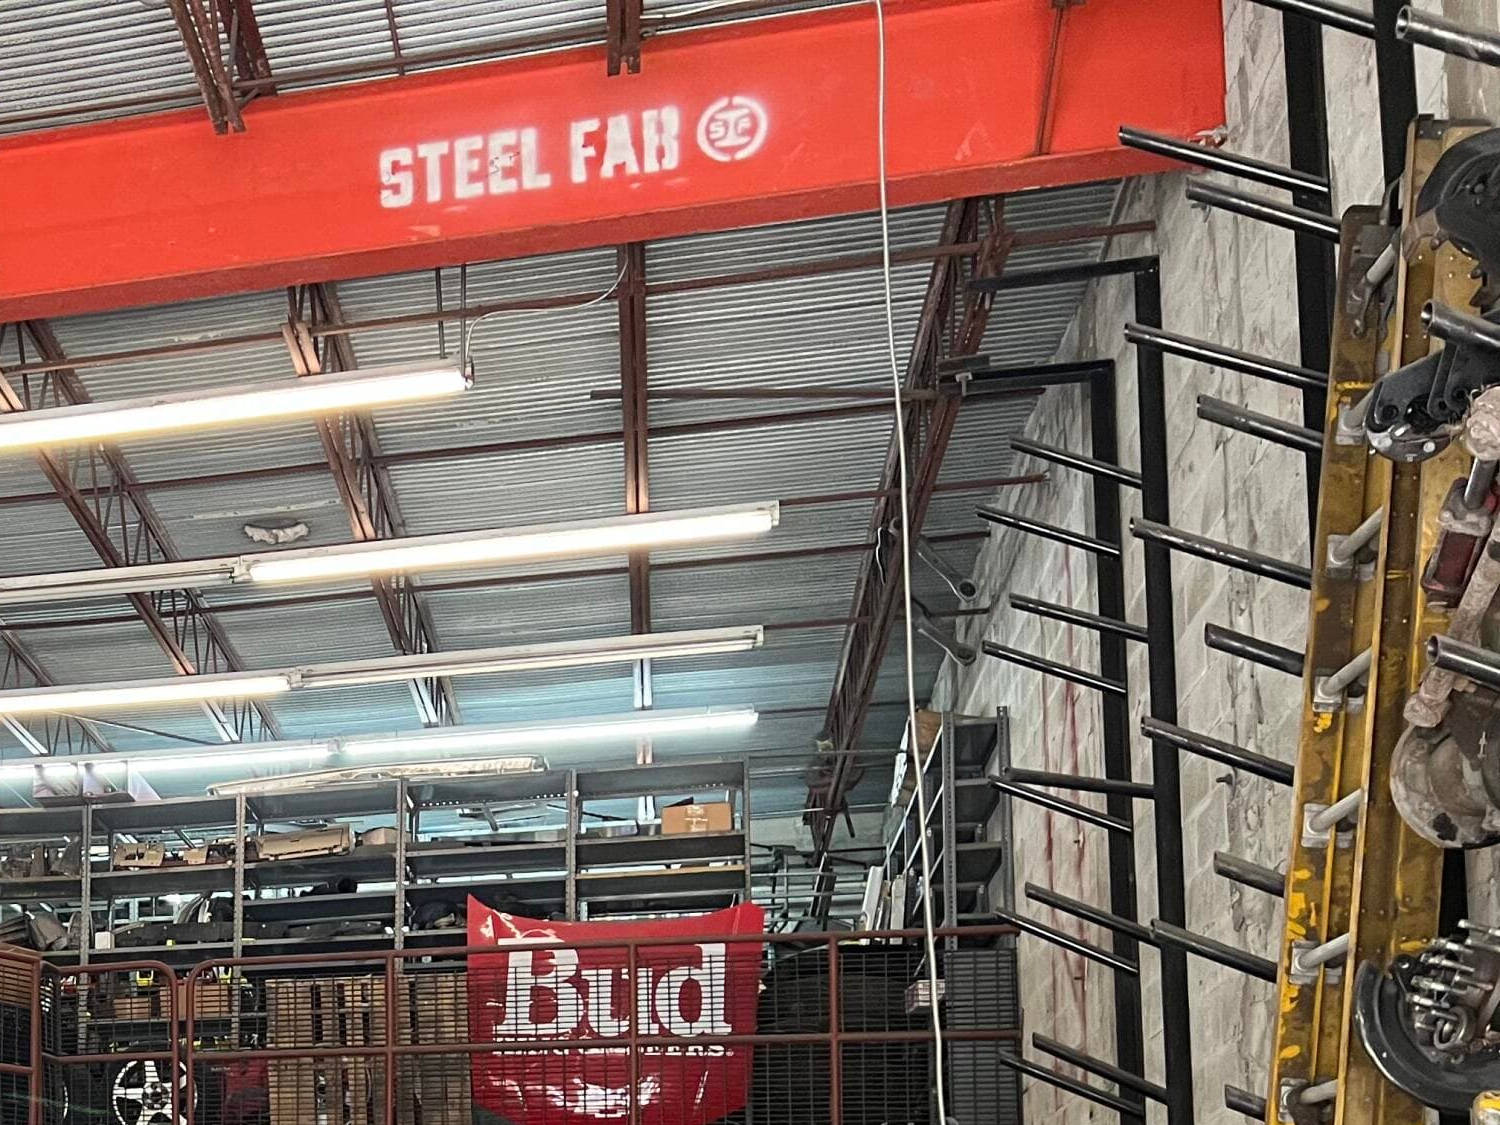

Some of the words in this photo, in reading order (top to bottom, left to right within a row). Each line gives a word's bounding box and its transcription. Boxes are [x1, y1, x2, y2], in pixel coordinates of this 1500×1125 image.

[379, 126, 552, 209] STEEL
[570, 104, 681, 185] FAB
[493, 937, 733, 1038] Bud
